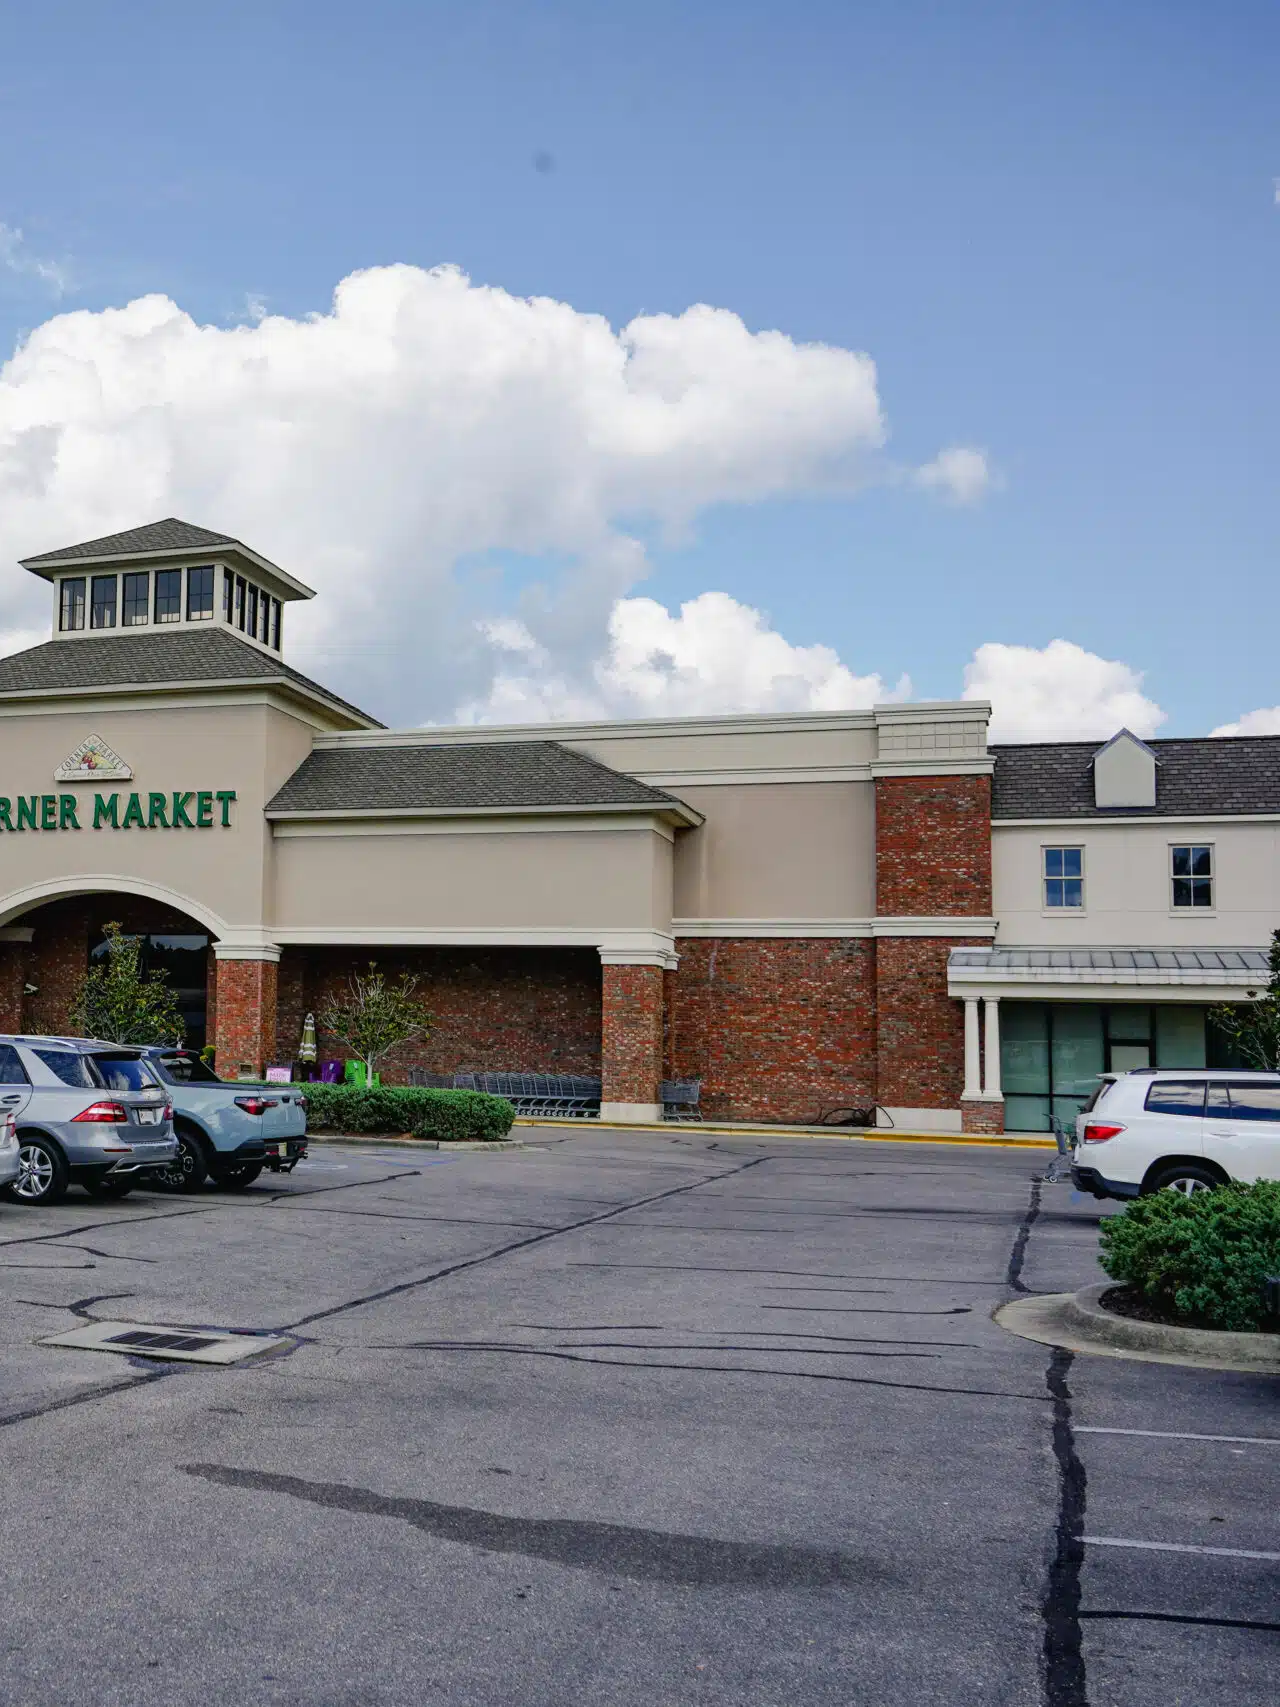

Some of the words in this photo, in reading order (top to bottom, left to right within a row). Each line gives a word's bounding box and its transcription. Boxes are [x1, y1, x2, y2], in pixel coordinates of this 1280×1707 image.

[61, 743, 90, 771] CORNER
[97, 743, 126, 771] MARKET
[92, 790, 237, 829] MARKET
